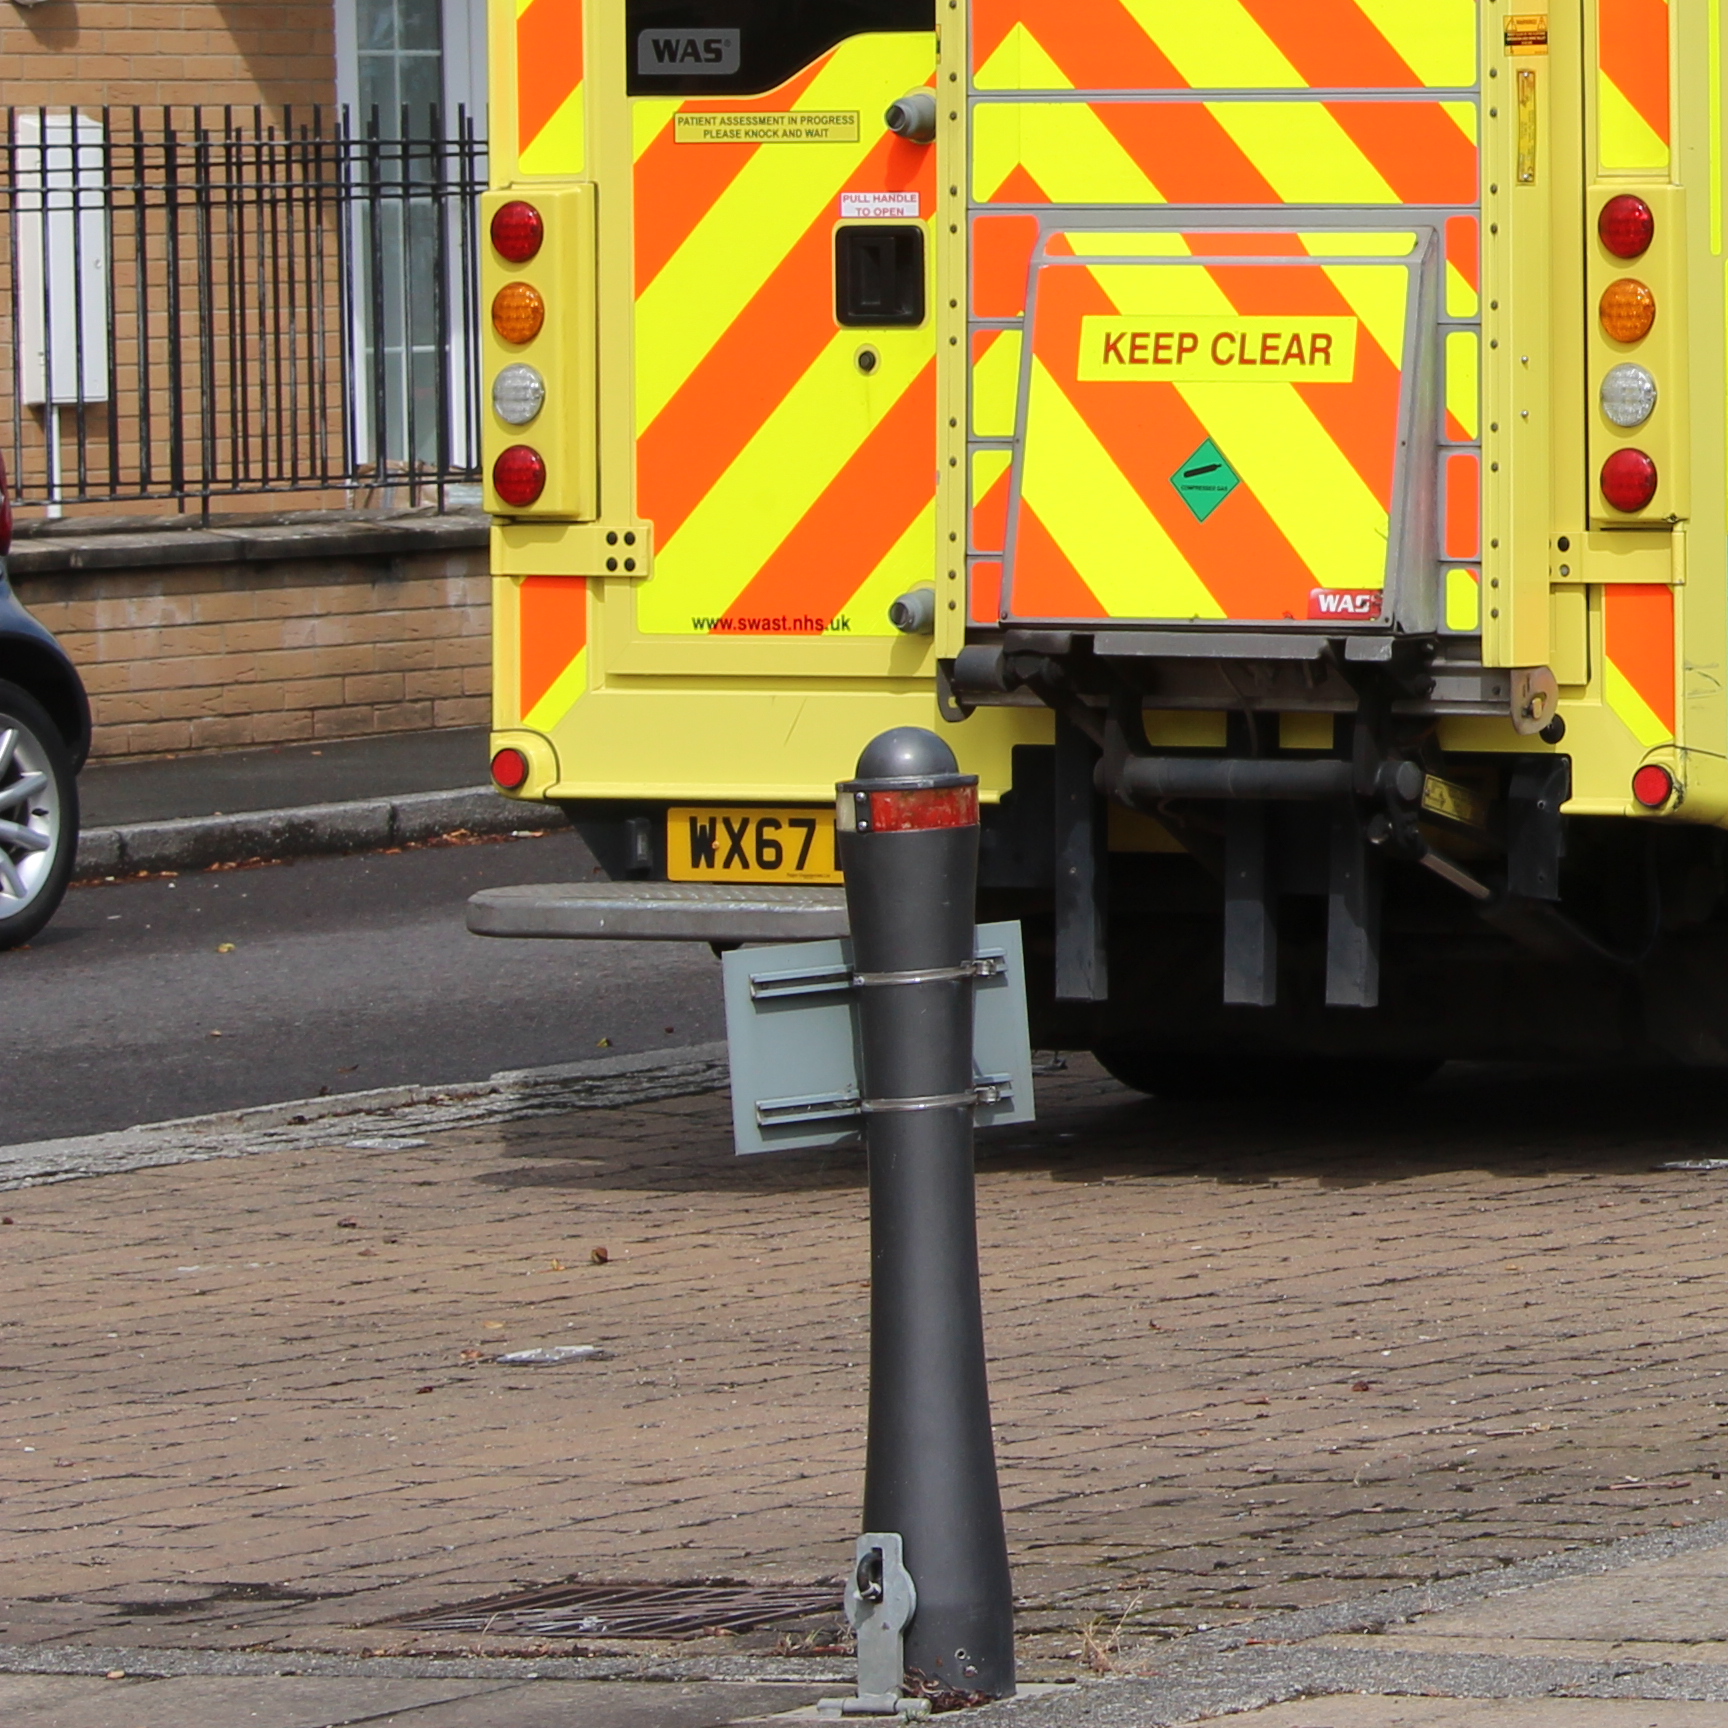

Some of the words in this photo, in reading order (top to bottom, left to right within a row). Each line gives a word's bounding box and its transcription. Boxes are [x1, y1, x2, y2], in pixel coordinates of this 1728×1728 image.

[651, 38, 723, 63] WAS
[678, 116, 717, 127] PATIENT
[719, 116, 785, 126] ASSESSMENT
[788, 116, 798, 125] IN
[800, 115, 855, 125] PROGRESS
[703, 129, 741, 139] PLEASE
[744, 129, 779, 138] KNOCK
[781, 129, 803, 138] AND
[805, 128, 829, 138] WAIT
[843, 194, 870, 203] PULL
[873, 194, 917, 203] HANDLE
[855, 207, 871, 217] TO
[873, 207, 905, 217] OPEN
[1103, 332, 1199, 365] KEEP
[1211, 332, 1333, 366] CLEAR
[1319, 595, 1370, 613] WAS
[692, 614, 851, 632] www.swast.nhs.uk
[689, 816, 816, 871] WX67
